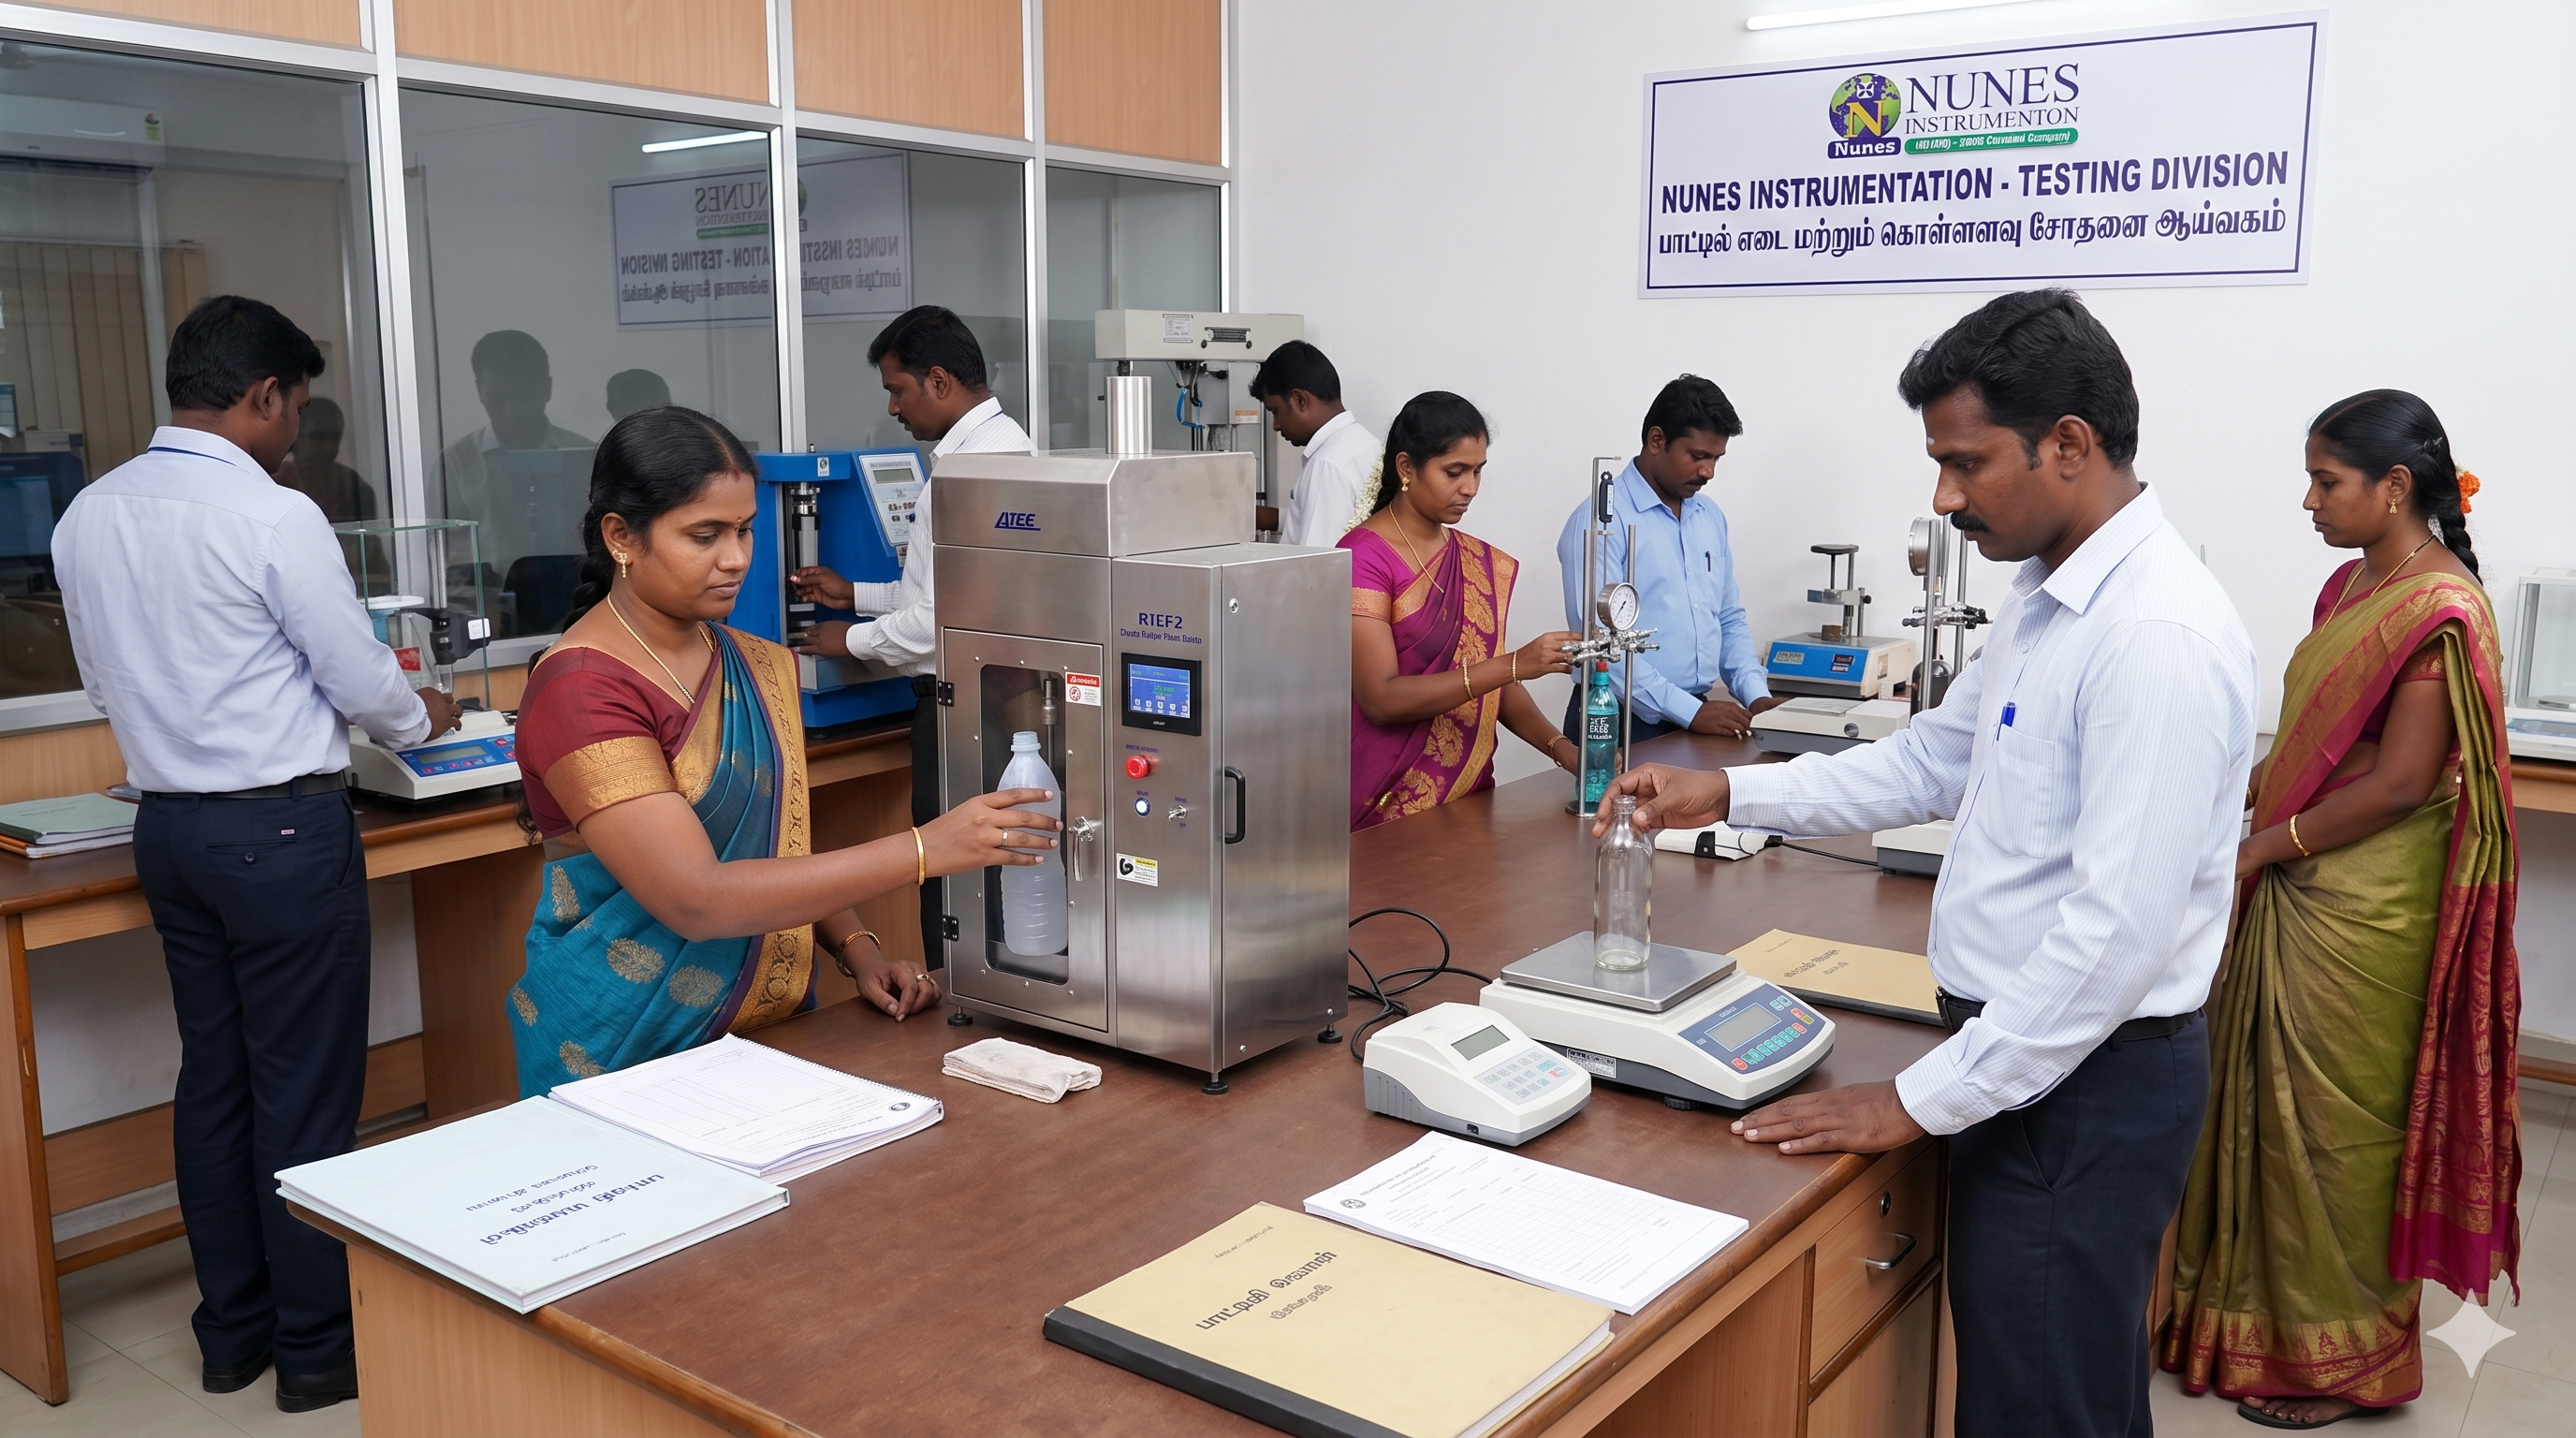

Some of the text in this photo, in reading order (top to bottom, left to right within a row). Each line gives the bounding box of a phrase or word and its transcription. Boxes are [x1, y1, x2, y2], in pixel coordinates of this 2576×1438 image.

[1905, 63, 2080, 114] NUNES
[1904, 106, 2080, 135] INSTRUMENTON
[1834, 139, 1895, 156] Nunes
[1661, 181, 1741, 214] NUNES
[1749, 166, 1993, 210] INSTRUMENTATION
[2018, 158, 2142, 197] TESTING
[2151, 151, 2289, 191] DIVISION
[1659, 197, 2287, 258] பாட்டில் எடை மற்றும் கொள்ளளவு சோதனை ஆய்வகம்
